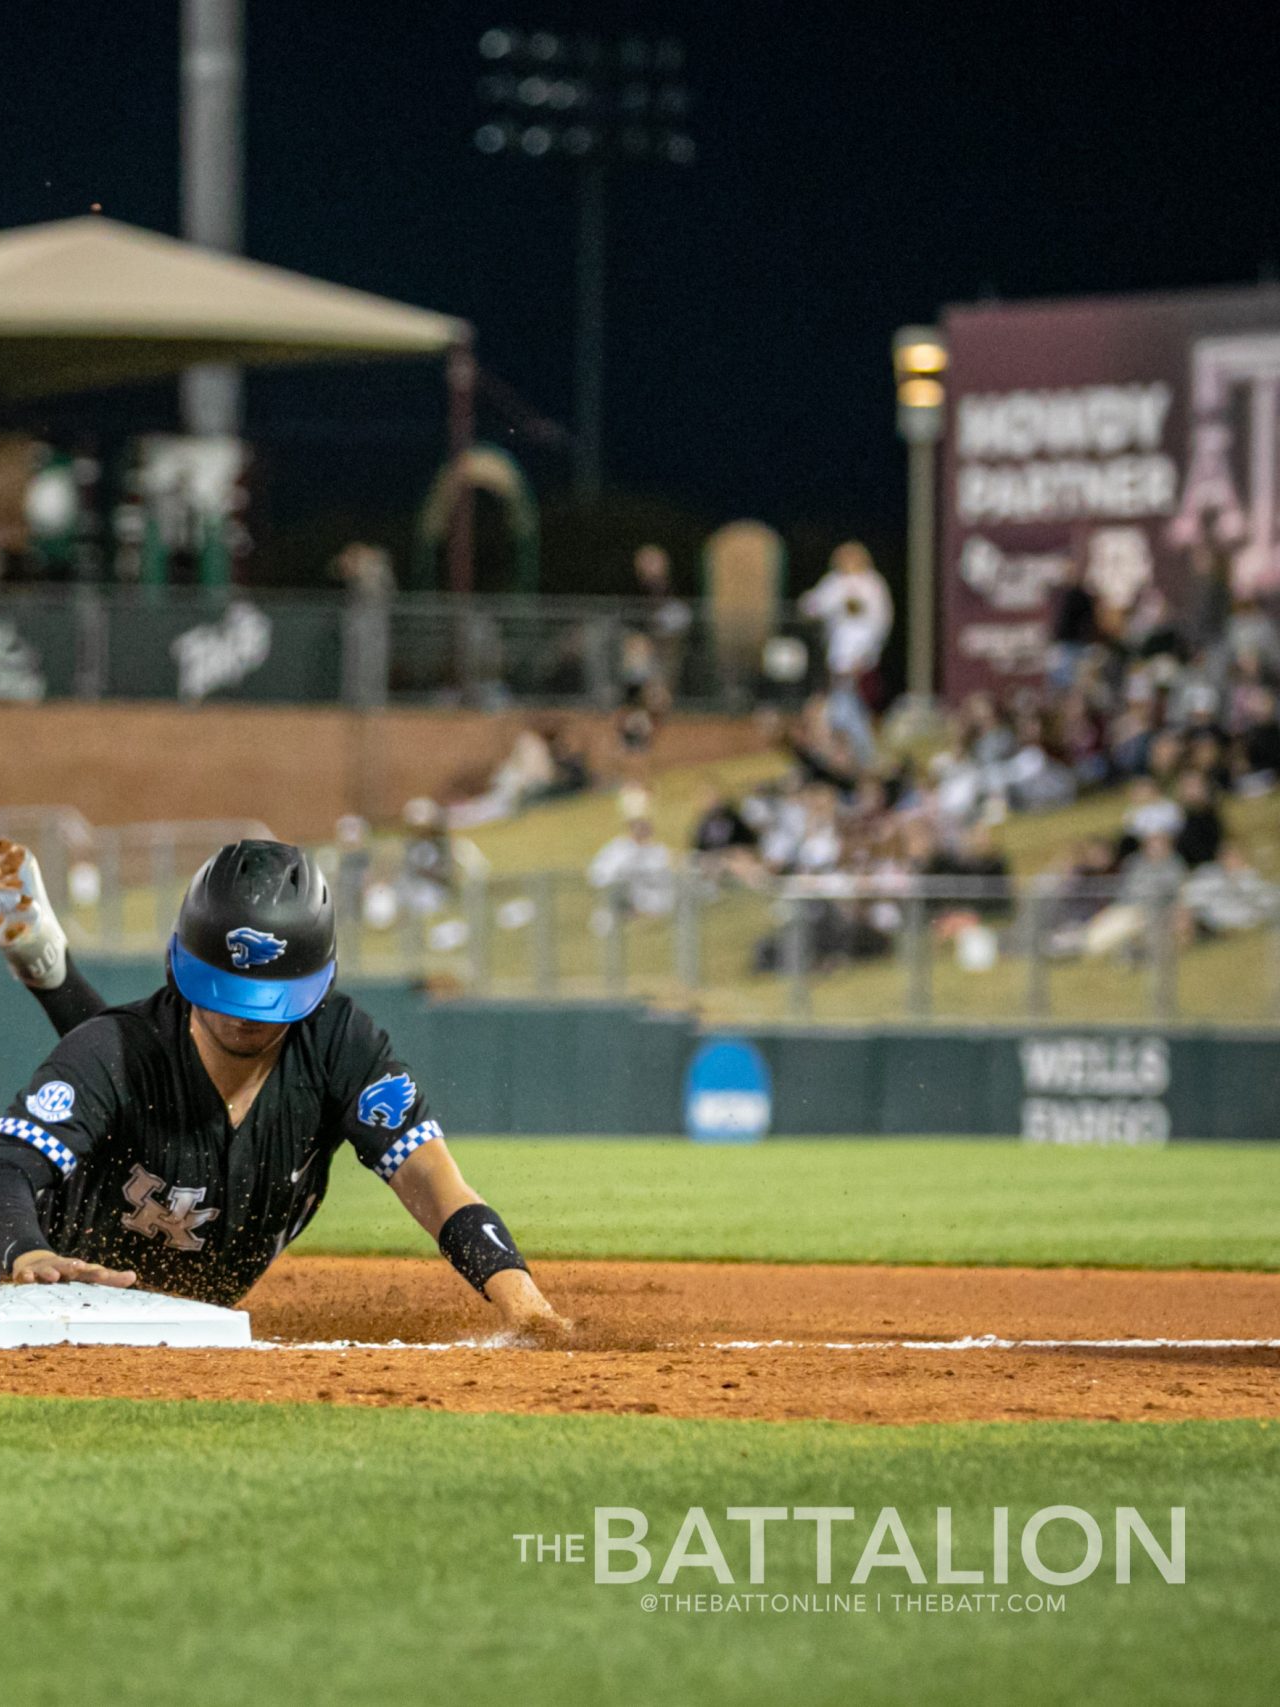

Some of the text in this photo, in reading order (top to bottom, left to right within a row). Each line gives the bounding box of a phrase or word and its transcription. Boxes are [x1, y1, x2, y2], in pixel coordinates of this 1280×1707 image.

[958, 381, 1169, 454] HOWDY
[958, 455, 1176, 521] PARTNER
[1021, 1037, 1168, 1089] WELLS
[39, 1083, 72, 1111] SEC
